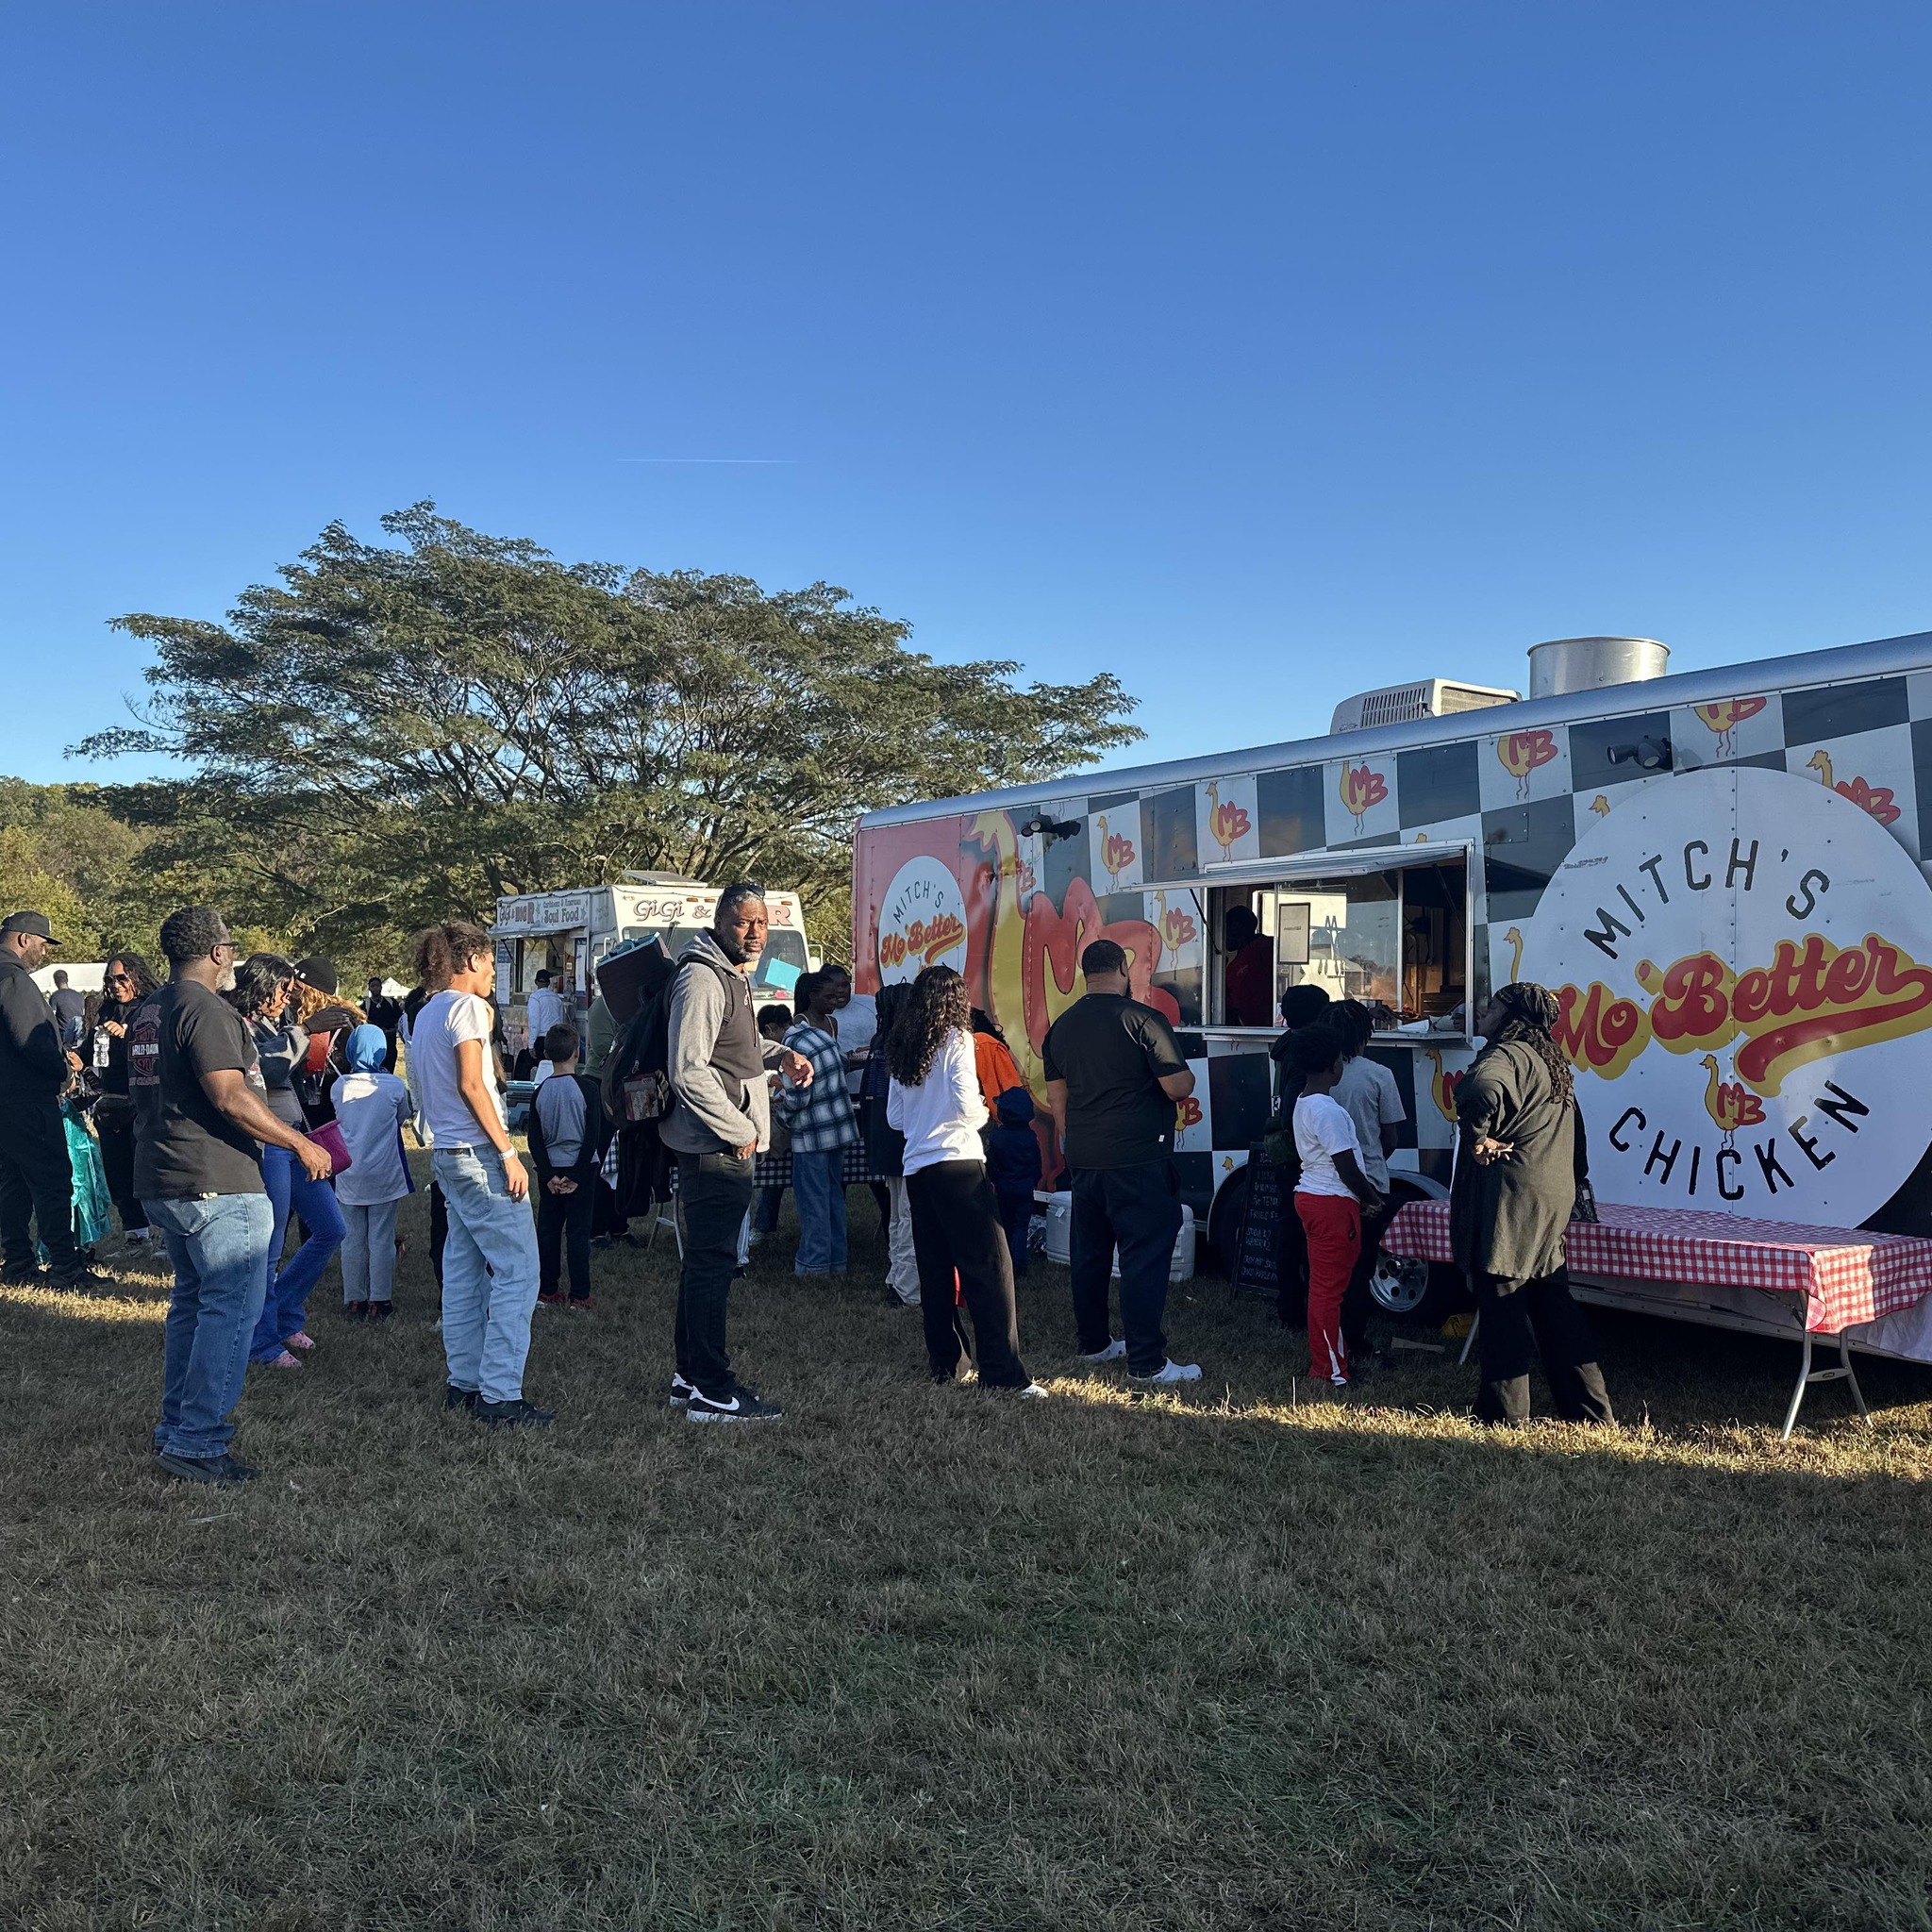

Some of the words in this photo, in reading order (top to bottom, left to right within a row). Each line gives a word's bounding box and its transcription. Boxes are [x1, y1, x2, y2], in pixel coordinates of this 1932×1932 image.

[1349, 765, 1388, 807] MB
[1218, 800, 1251, 839] MB
[1108, 832, 1135, 868] MB
[544, 909, 558, 924] Soul
[561, 907, 578, 923] Food
[691, 905, 711, 919] &
[893, 880, 944, 924] MITCH'S
[1584, 838, 1830, 960] MITCH'S
[1166, 907, 1196, 944] MB
[1717, 1082, 1766, 1125] MB
[1609, 1080, 1870, 1200] CHICKEN
